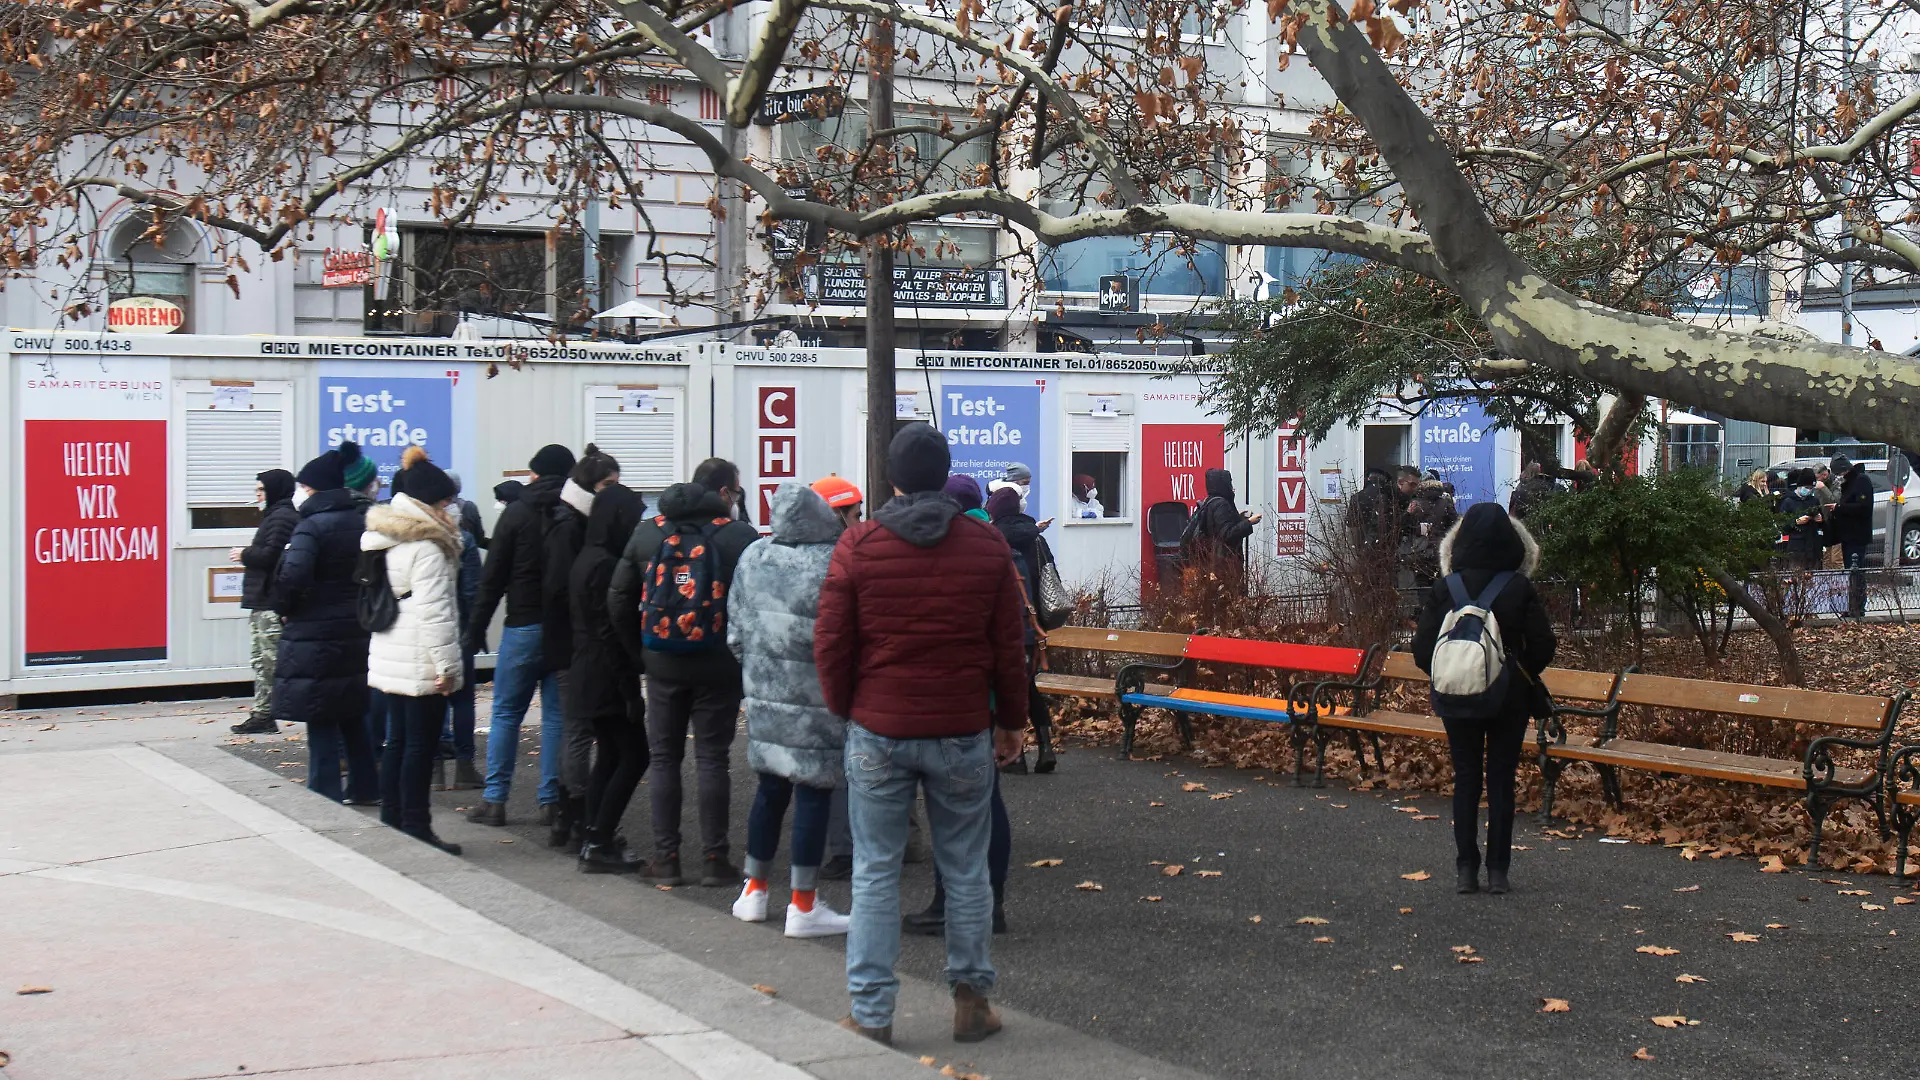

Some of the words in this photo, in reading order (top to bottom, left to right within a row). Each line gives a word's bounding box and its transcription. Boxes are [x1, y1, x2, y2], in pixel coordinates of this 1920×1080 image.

[913, 270, 941, 280] ALLER
[107, 307, 181, 326] MORENO
[14, 337, 53, 350] CHVU
[64, 339, 132, 351] 500.143-8
[261, 342, 299, 354] CHV
[308, 343, 458, 357] MIETCONTAINER
[590, 349, 682, 362] www.chv.at
[735, 351, 764, 361] CHVU
[769, 352, 787, 363] 500
[790, 353, 818, 363] 298-5
[915, 356, 944, 367] CHV
[950, 357, 1060, 369] MIETCONTAINER
[1065, 359, 1086, 369] Tel.
[1088, 359, 1157, 371] 01/8652050
[27, 380, 163, 390] SAMARITERBUND
[124, 392, 163, 401] WIEN
[327, 386, 406, 413] Test-
[947, 393, 1005, 416] Test-
[327, 419, 428, 446] straße
[947, 421, 1022, 445] straße
[1424, 421, 1481, 443] straße
[63, 441, 131, 477] HELFEN
[951, 459, 968, 468] ühre
[969, 459, 983, 468] hier
[1164, 440, 1203, 468] HELFEN
[1170, 473, 1195, 501] WIR
[76, 484, 119, 520] WIR
[34, 526, 159, 564] GEMEINSAM
